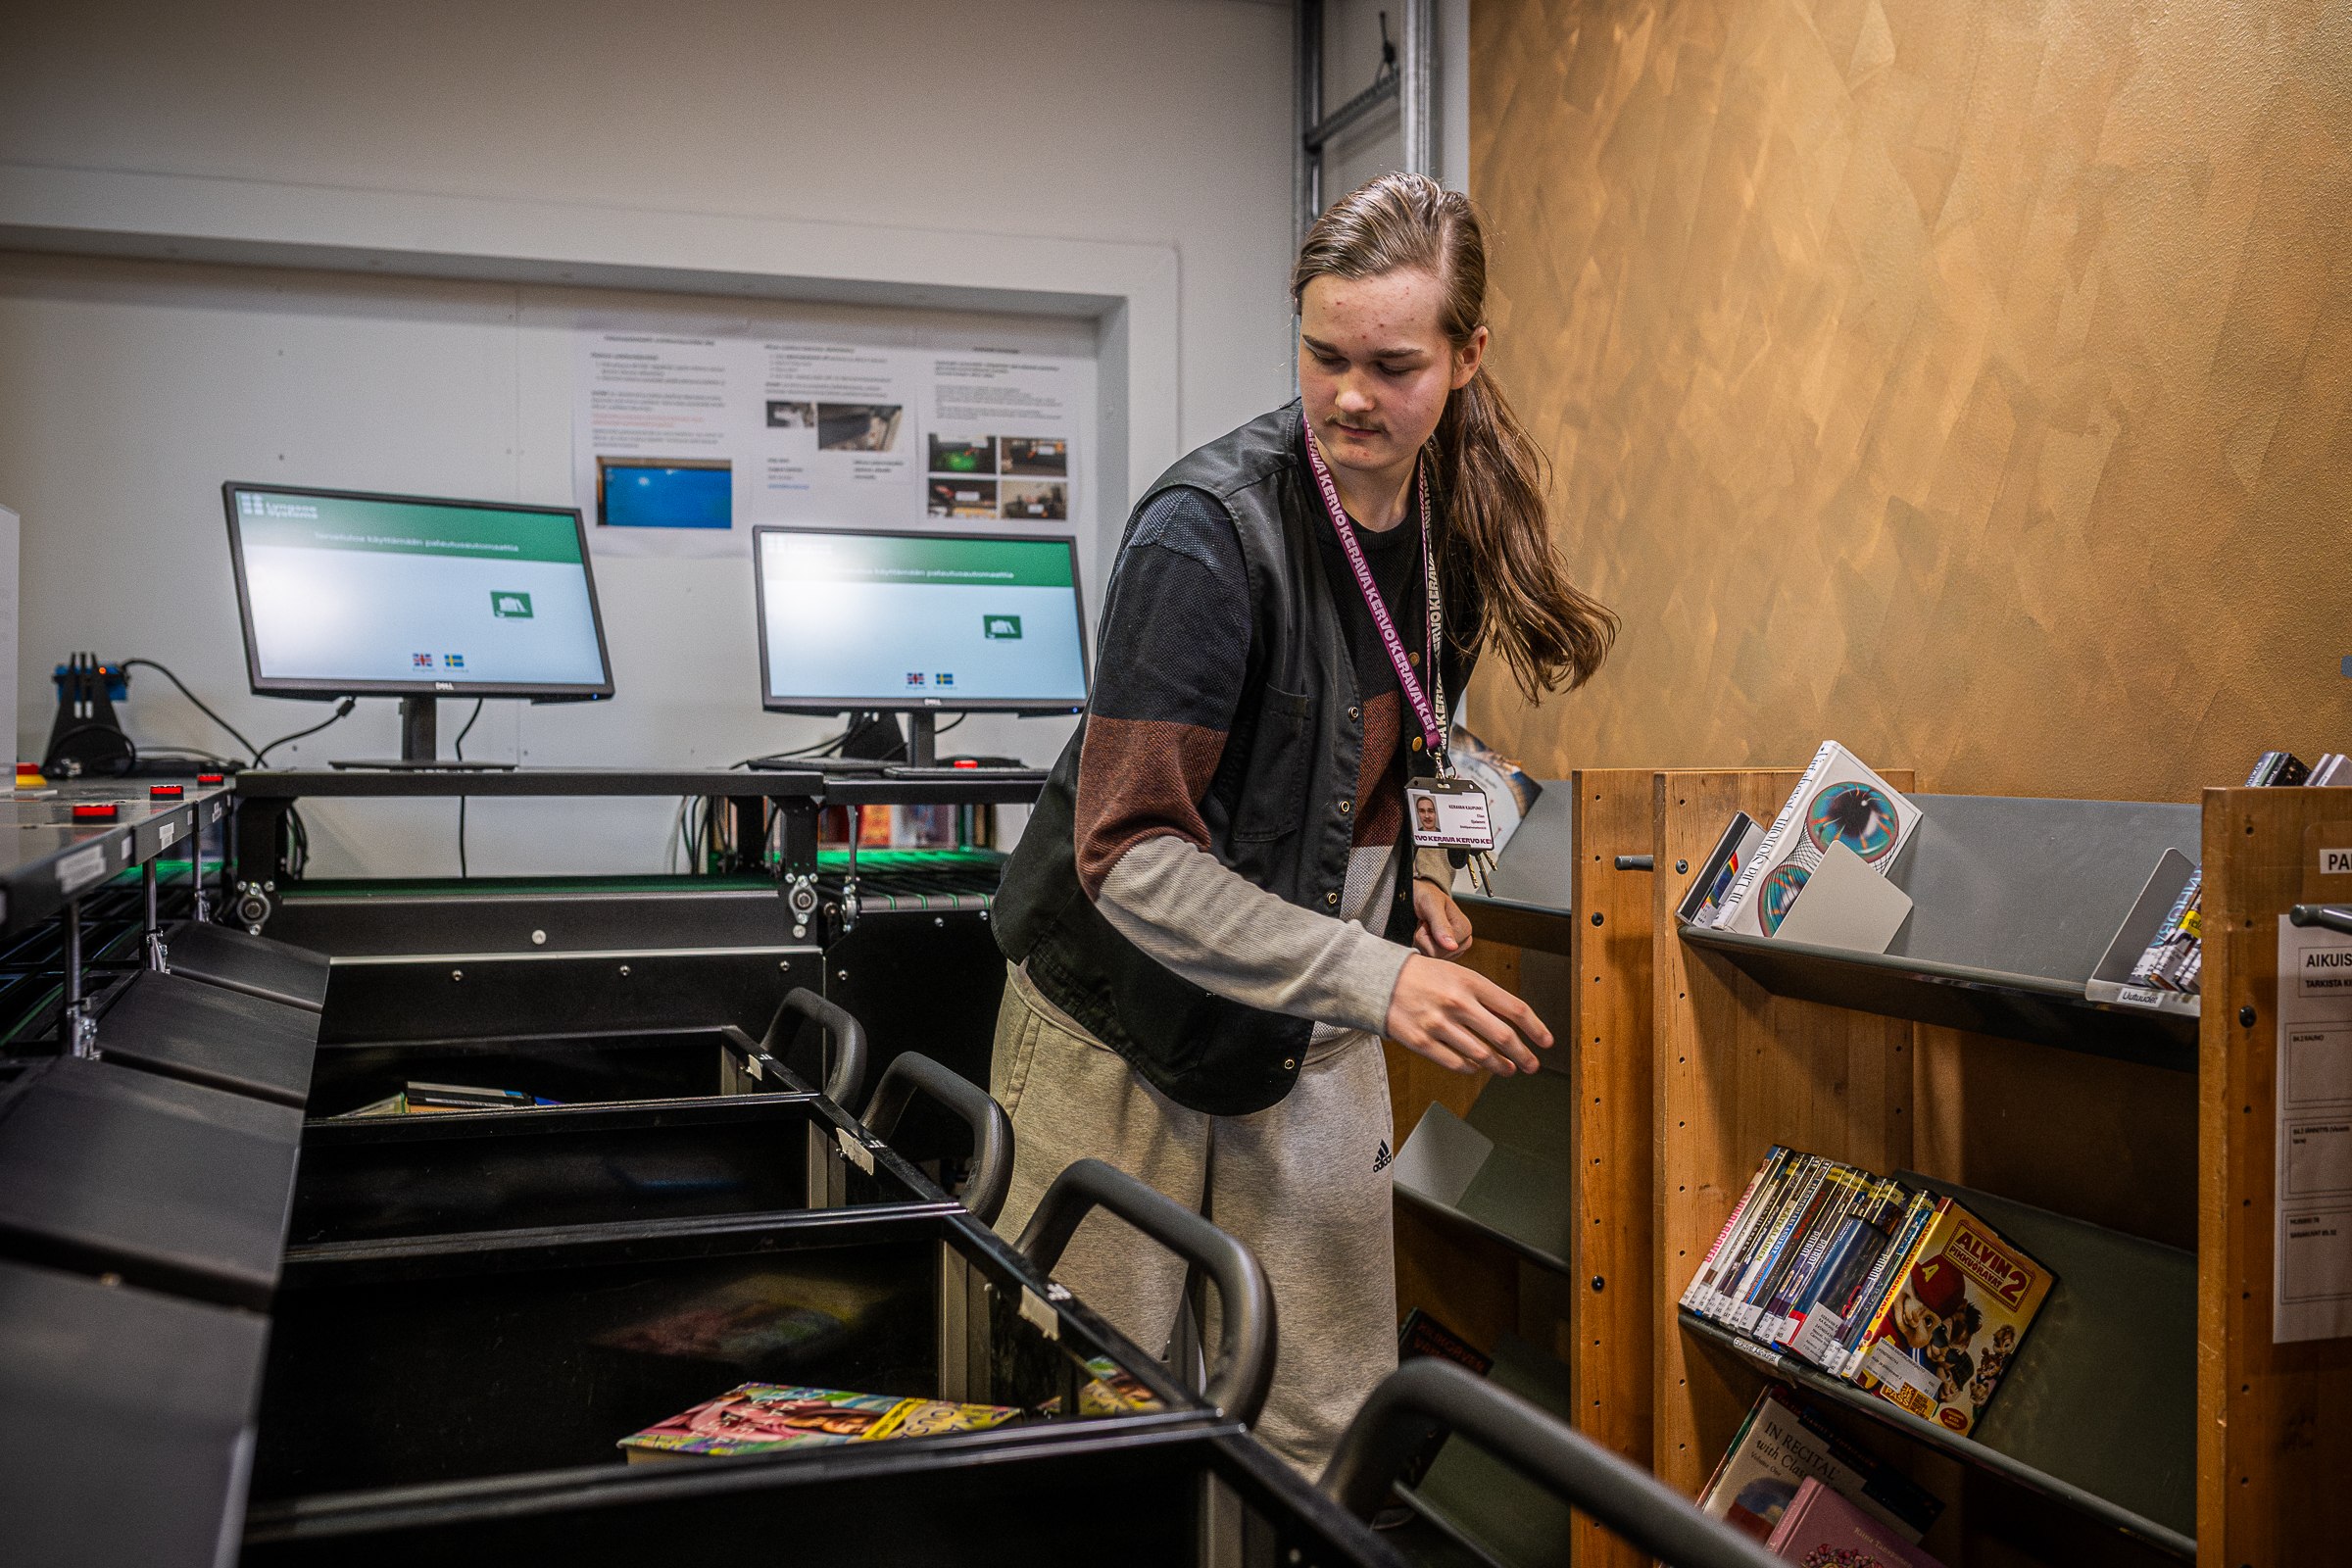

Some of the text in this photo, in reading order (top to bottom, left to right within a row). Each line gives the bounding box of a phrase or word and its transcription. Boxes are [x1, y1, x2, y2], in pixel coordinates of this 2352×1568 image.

[1319, 473, 1348, 526] KERVO
[1340, 525, 1373, 589] KERAVA
[1364, 587, 1397, 642] KERVO
[1389, 639, 1424, 705] KERAVA
[2122, 991, 2159, 1004] Uutuudet
[1373, 1153, 1393, 1173] adidas
[1809, 1189, 1826, 1212] TWIN
[1703, 1200, 1745, 1265] UNDERCOVER
[1755, 1206, 1791, 1262] KÄTKÄLÄINEN
[1791, 1212, 1812, 1241] PEAKS
[1798, 1229, 1820, 1258] POIROT
[1806, 1238, 1827, 1266] POIROT
[1866, 1251, 1889, 1282] POIROT
[1922, 1264, 1939, 1283] A
[1954, 1230, 2030, 1304] ALVIN 2
[1885, 1387, 1909, 1406] PASS
[1750, 1451, 1769, 1468] Volume
[1755, 1437, 1781, 1460] with
[1764, 1420, 1783, 1441] IN
[1781, 1433, 1838, 1480] RECITAL
